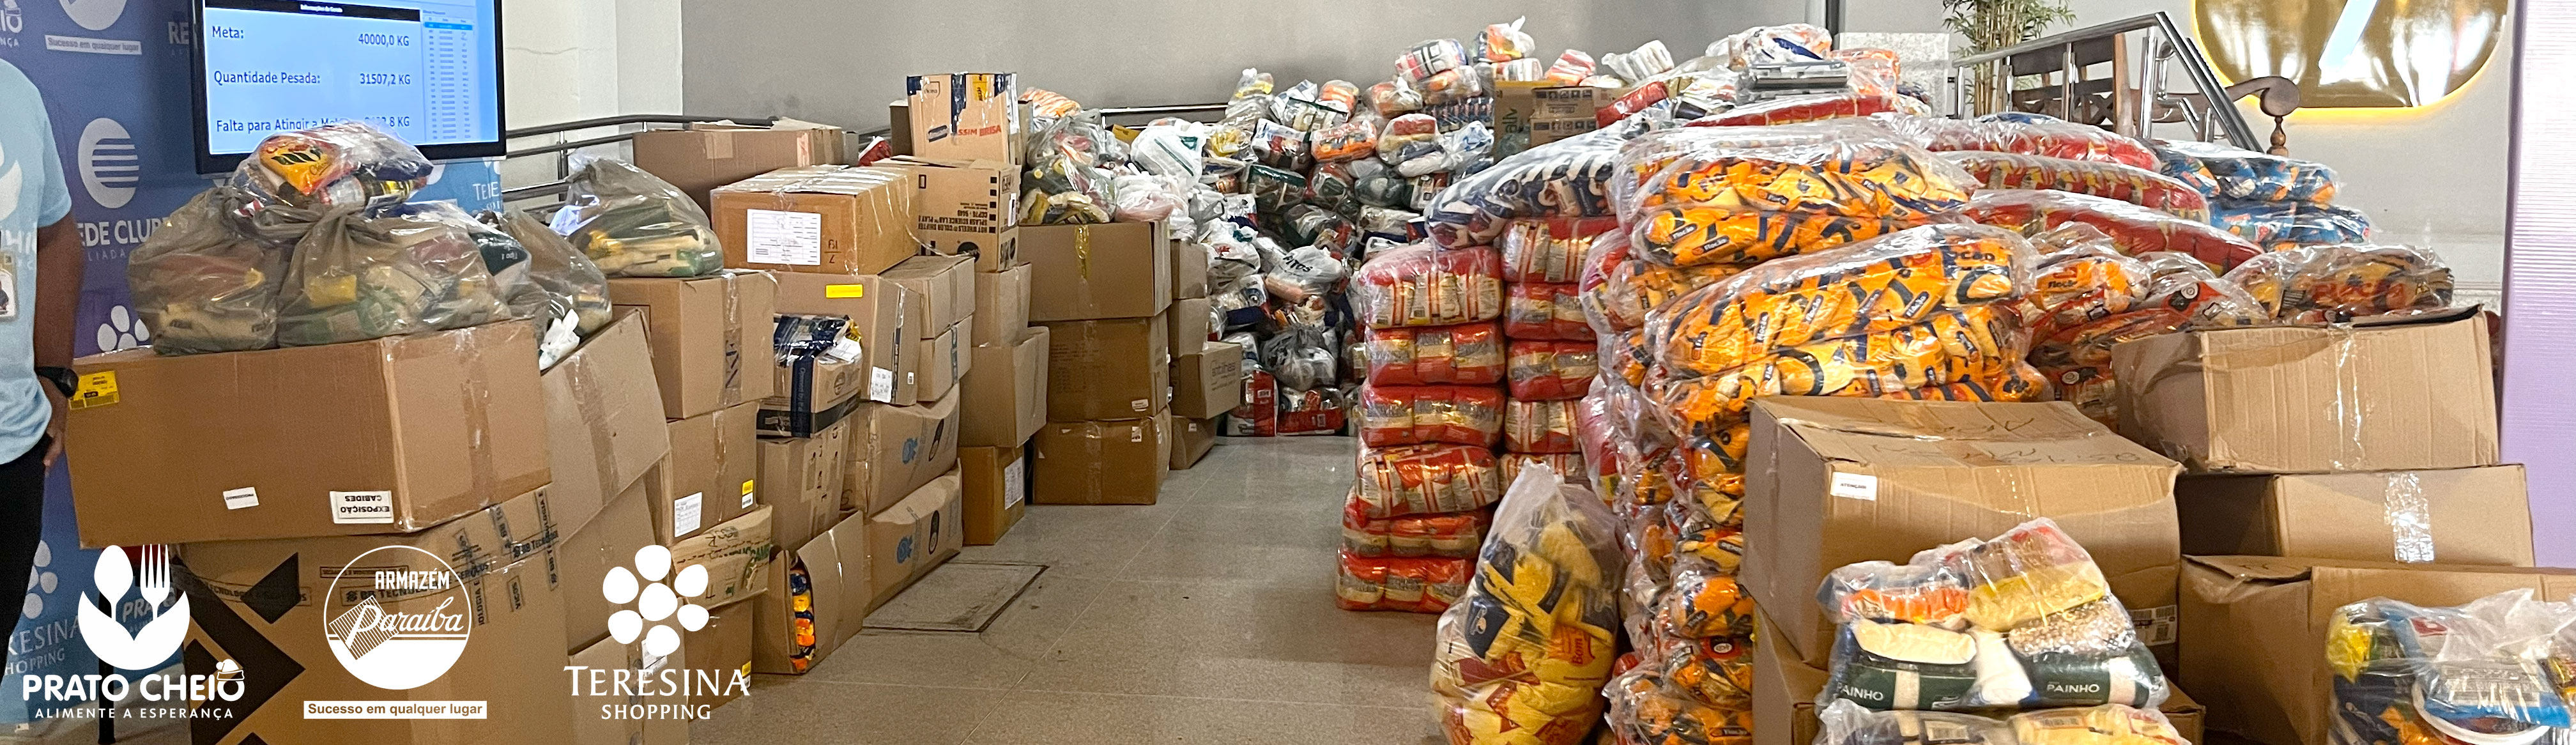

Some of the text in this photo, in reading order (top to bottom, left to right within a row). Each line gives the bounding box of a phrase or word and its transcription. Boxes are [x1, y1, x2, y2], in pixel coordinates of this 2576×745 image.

[212, 26, 244, 39] Meta:
[48, 37, 77, 48] Sucesso
[93, 42, 121, 50] qualquer
[122, 43, 139, 52] lugar
[358, 33, 410, 47] 40000,0 KG
[214, 70, 320, 86] Quantidade Pesada:
[360, 73, 410, 87] 31507,2 KG
[217, 119, 244, 132] Falta
[248, 122, 271, 134] para
[275, 118, 309, 130] Atingir
[397, 116, 410, 127] KG
[969, 218, 987, 226] SPLASH
[340, 505, 390, 514] EXPOSIÇÃO
[2046, 683, 2100, 693] PAINHO
